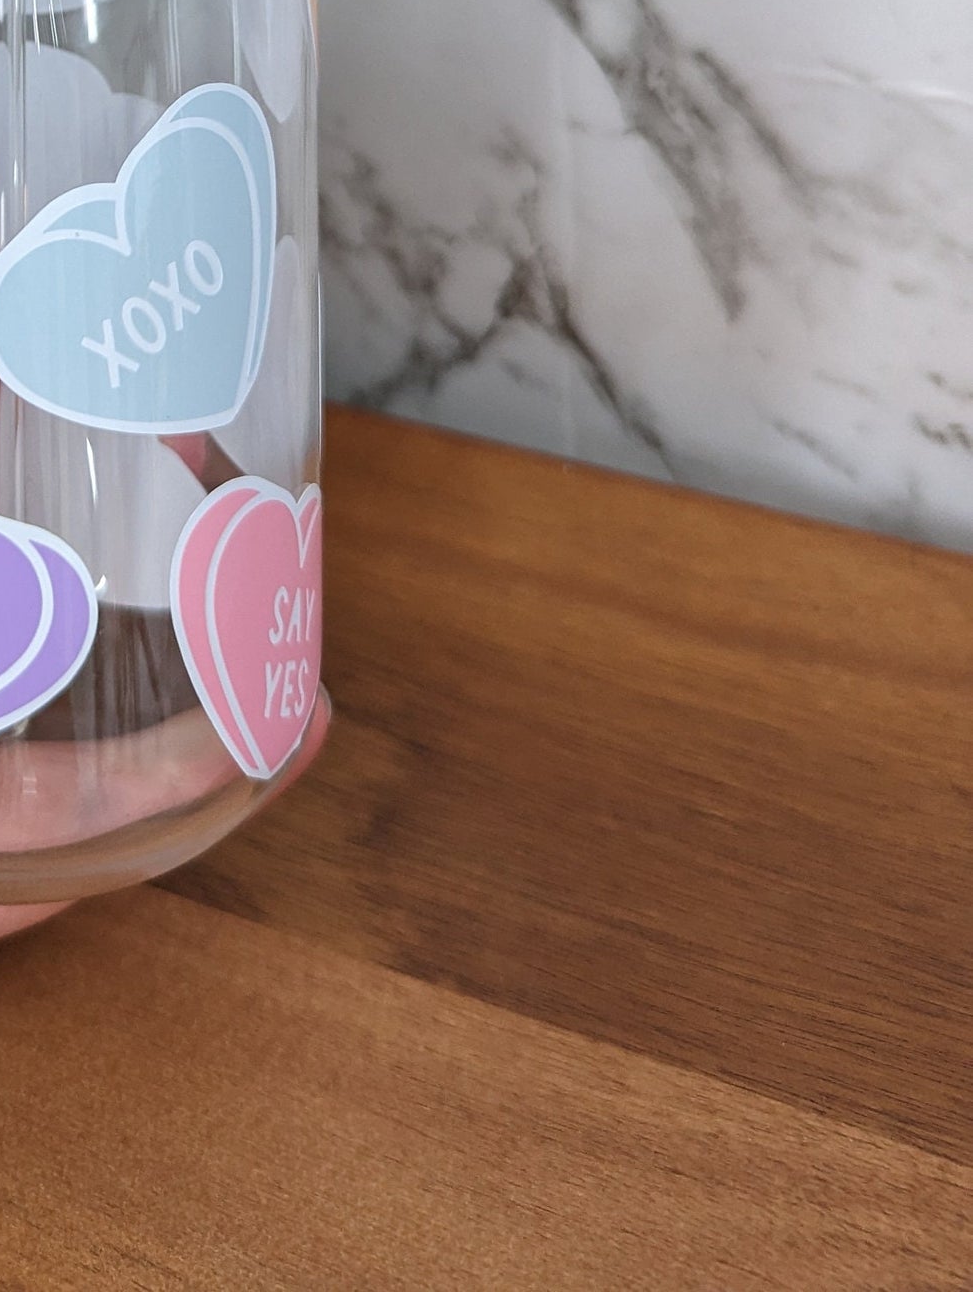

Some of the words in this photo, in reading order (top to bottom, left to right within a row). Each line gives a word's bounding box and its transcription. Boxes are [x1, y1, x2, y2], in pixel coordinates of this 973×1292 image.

[80, 239, 225, 389] XOXO
[268, 585, 316, 645] SAY
[263, 656, 309, 720] YES
